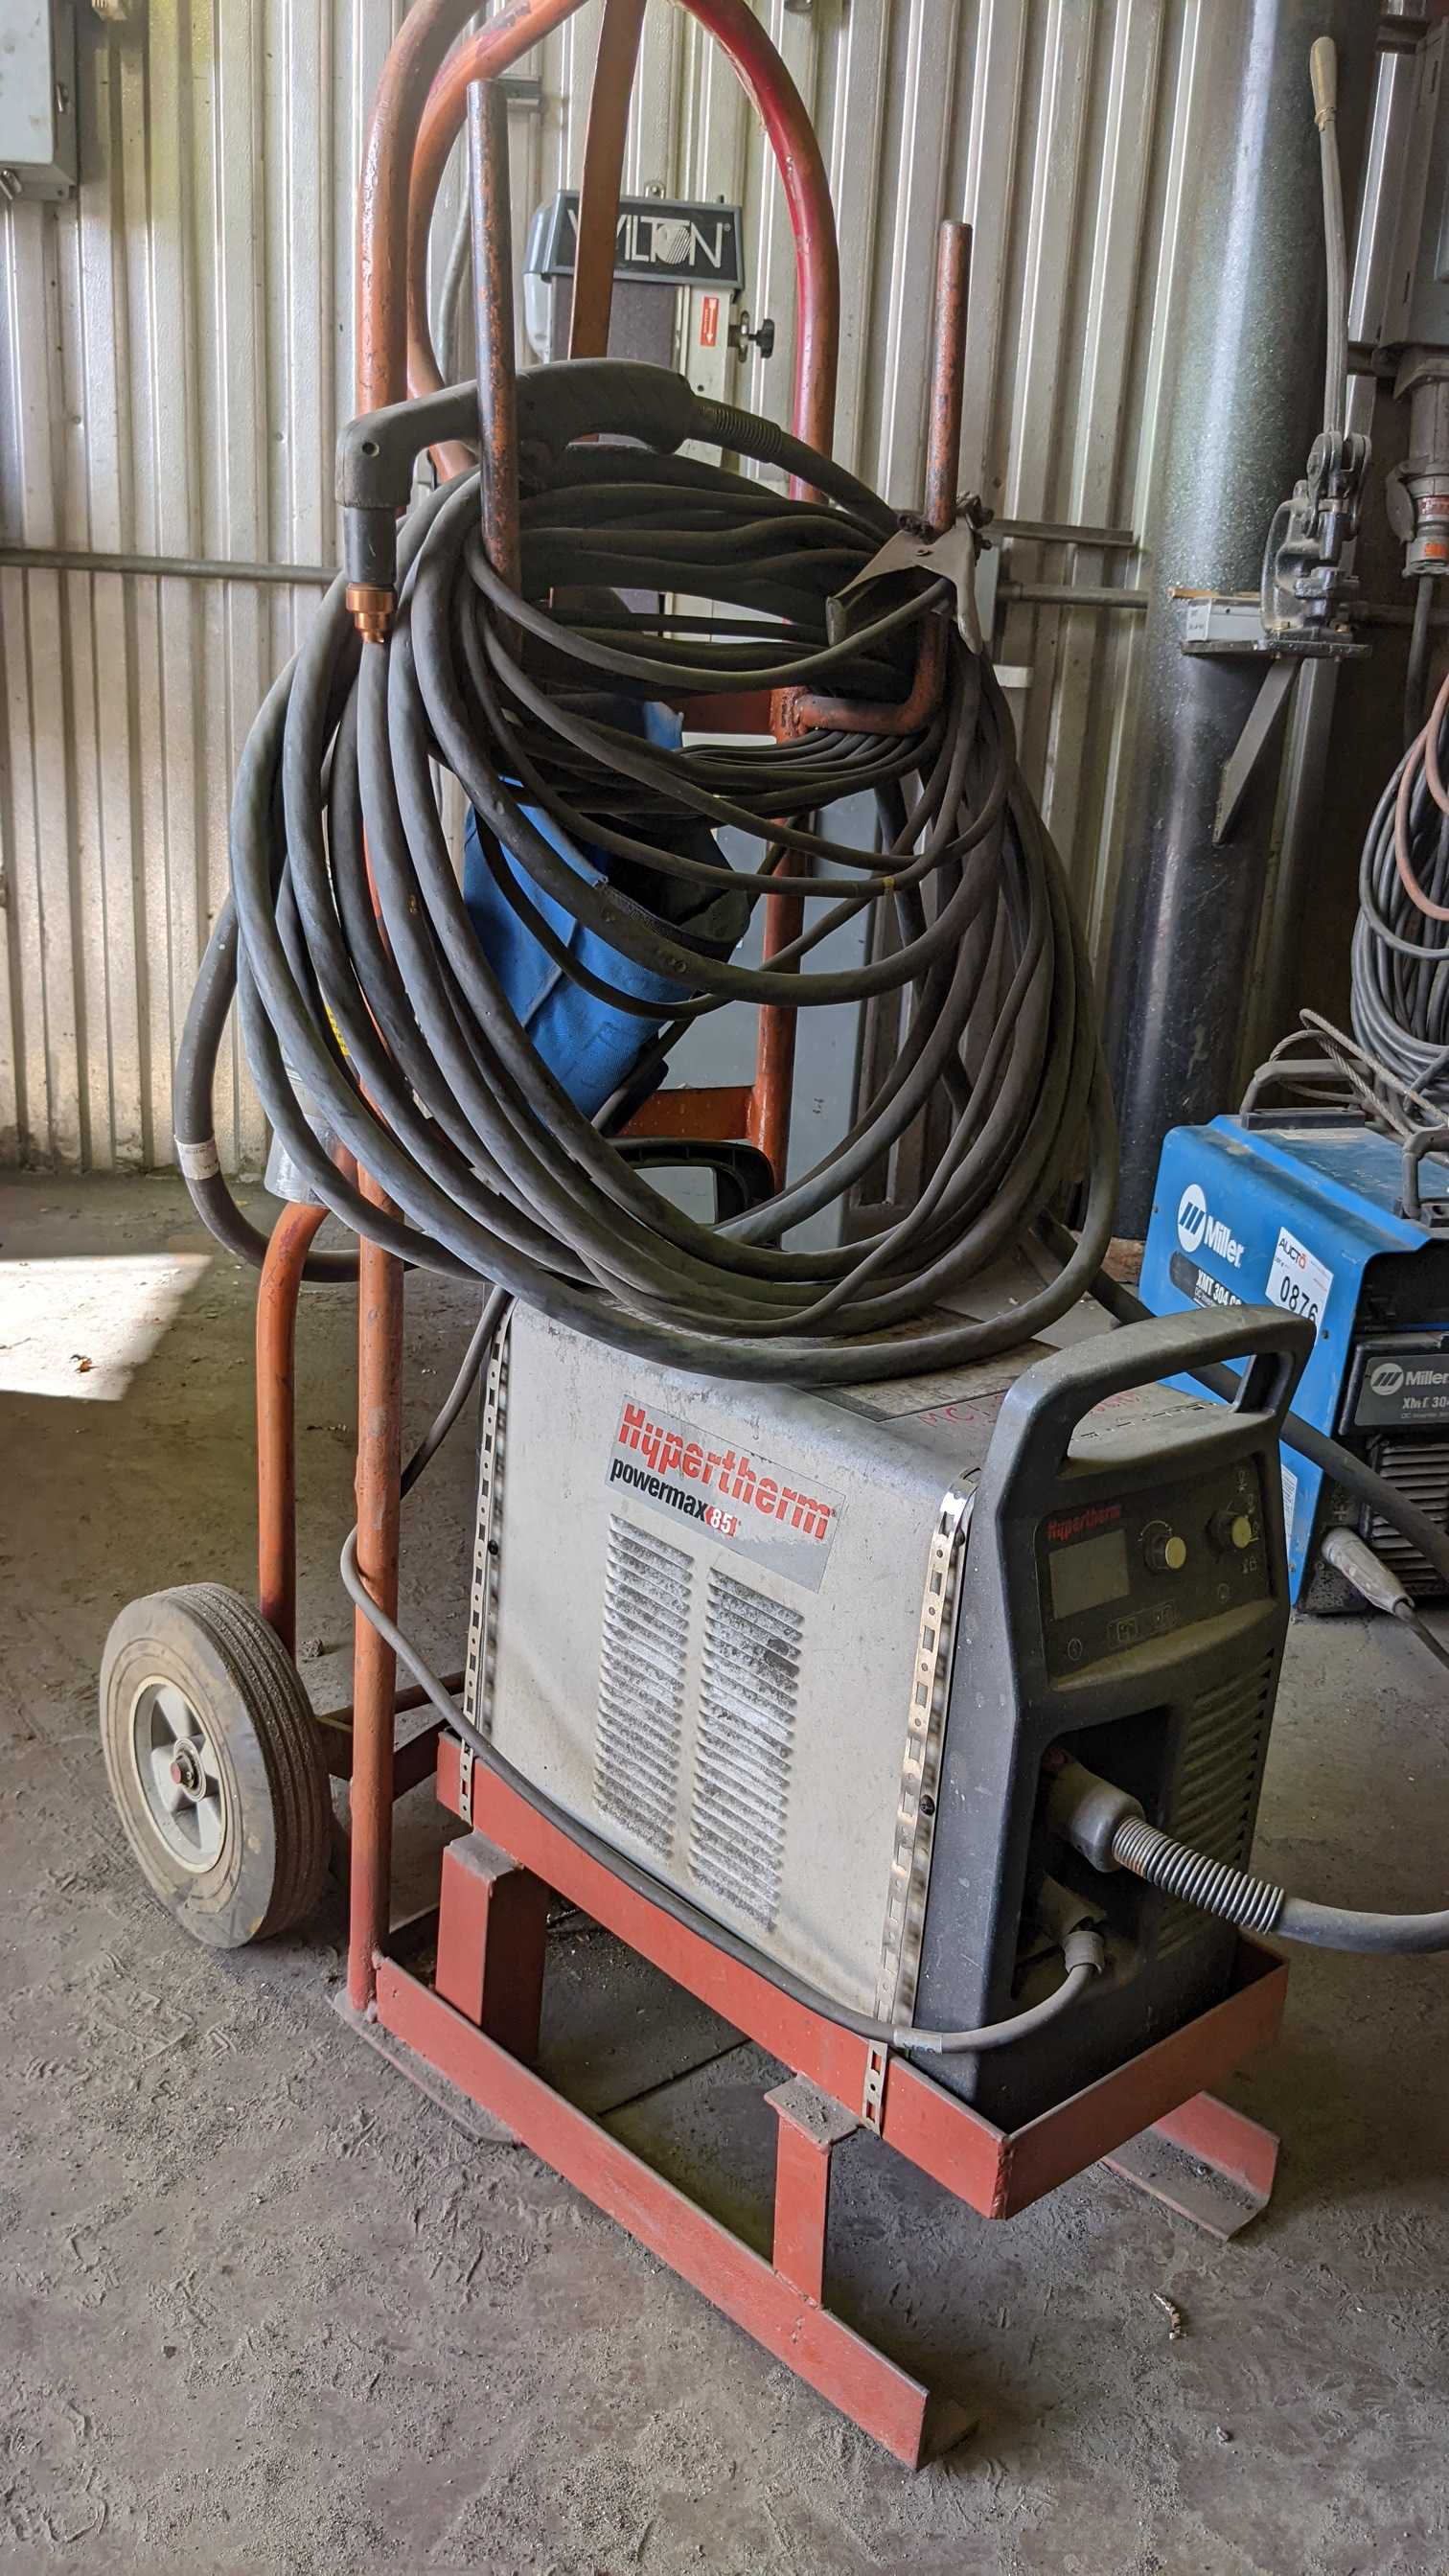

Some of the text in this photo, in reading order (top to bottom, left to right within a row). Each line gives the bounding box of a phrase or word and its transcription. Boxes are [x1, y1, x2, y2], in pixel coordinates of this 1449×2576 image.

[1204, 1214, 1244, 1268] Miller
[1196, 1268, 1214, 1297] XMT
[1280, 1276, 1319, 1322] 0876
[1405, 1370, 1449, 1386] Miller
[1402, 1396, 1430, 1410] XMT
[618, 1403, 829, 1541] Hypertherm
